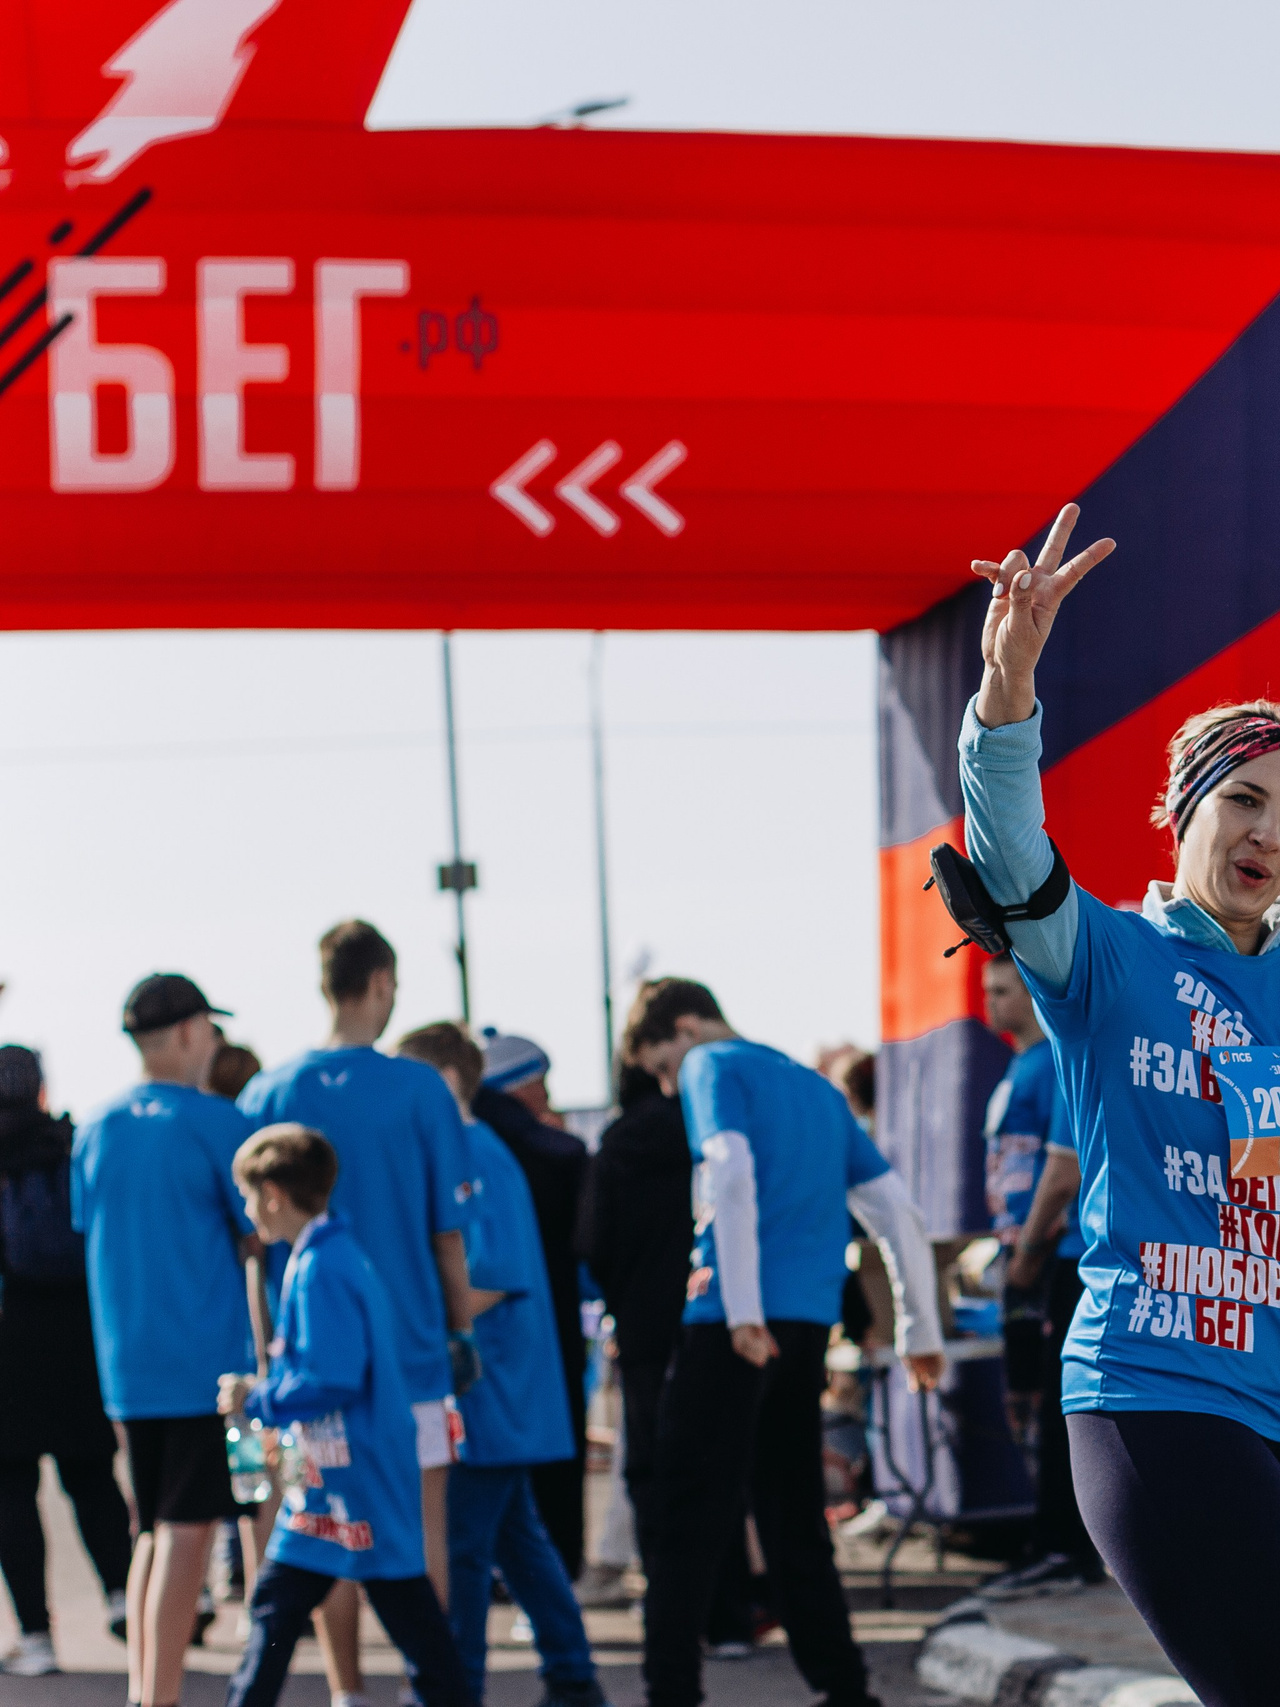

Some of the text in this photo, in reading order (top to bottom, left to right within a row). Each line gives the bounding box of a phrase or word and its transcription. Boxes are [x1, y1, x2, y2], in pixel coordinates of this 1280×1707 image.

[48, 256, 410, 494] БЕГ
[1129, 1036, 1222, 1103] #ЗАБ
[1231, 1052, 1252, 1063] ПСБ
[1128, 1285, 1253, 1352] #ЗАБЕГ
